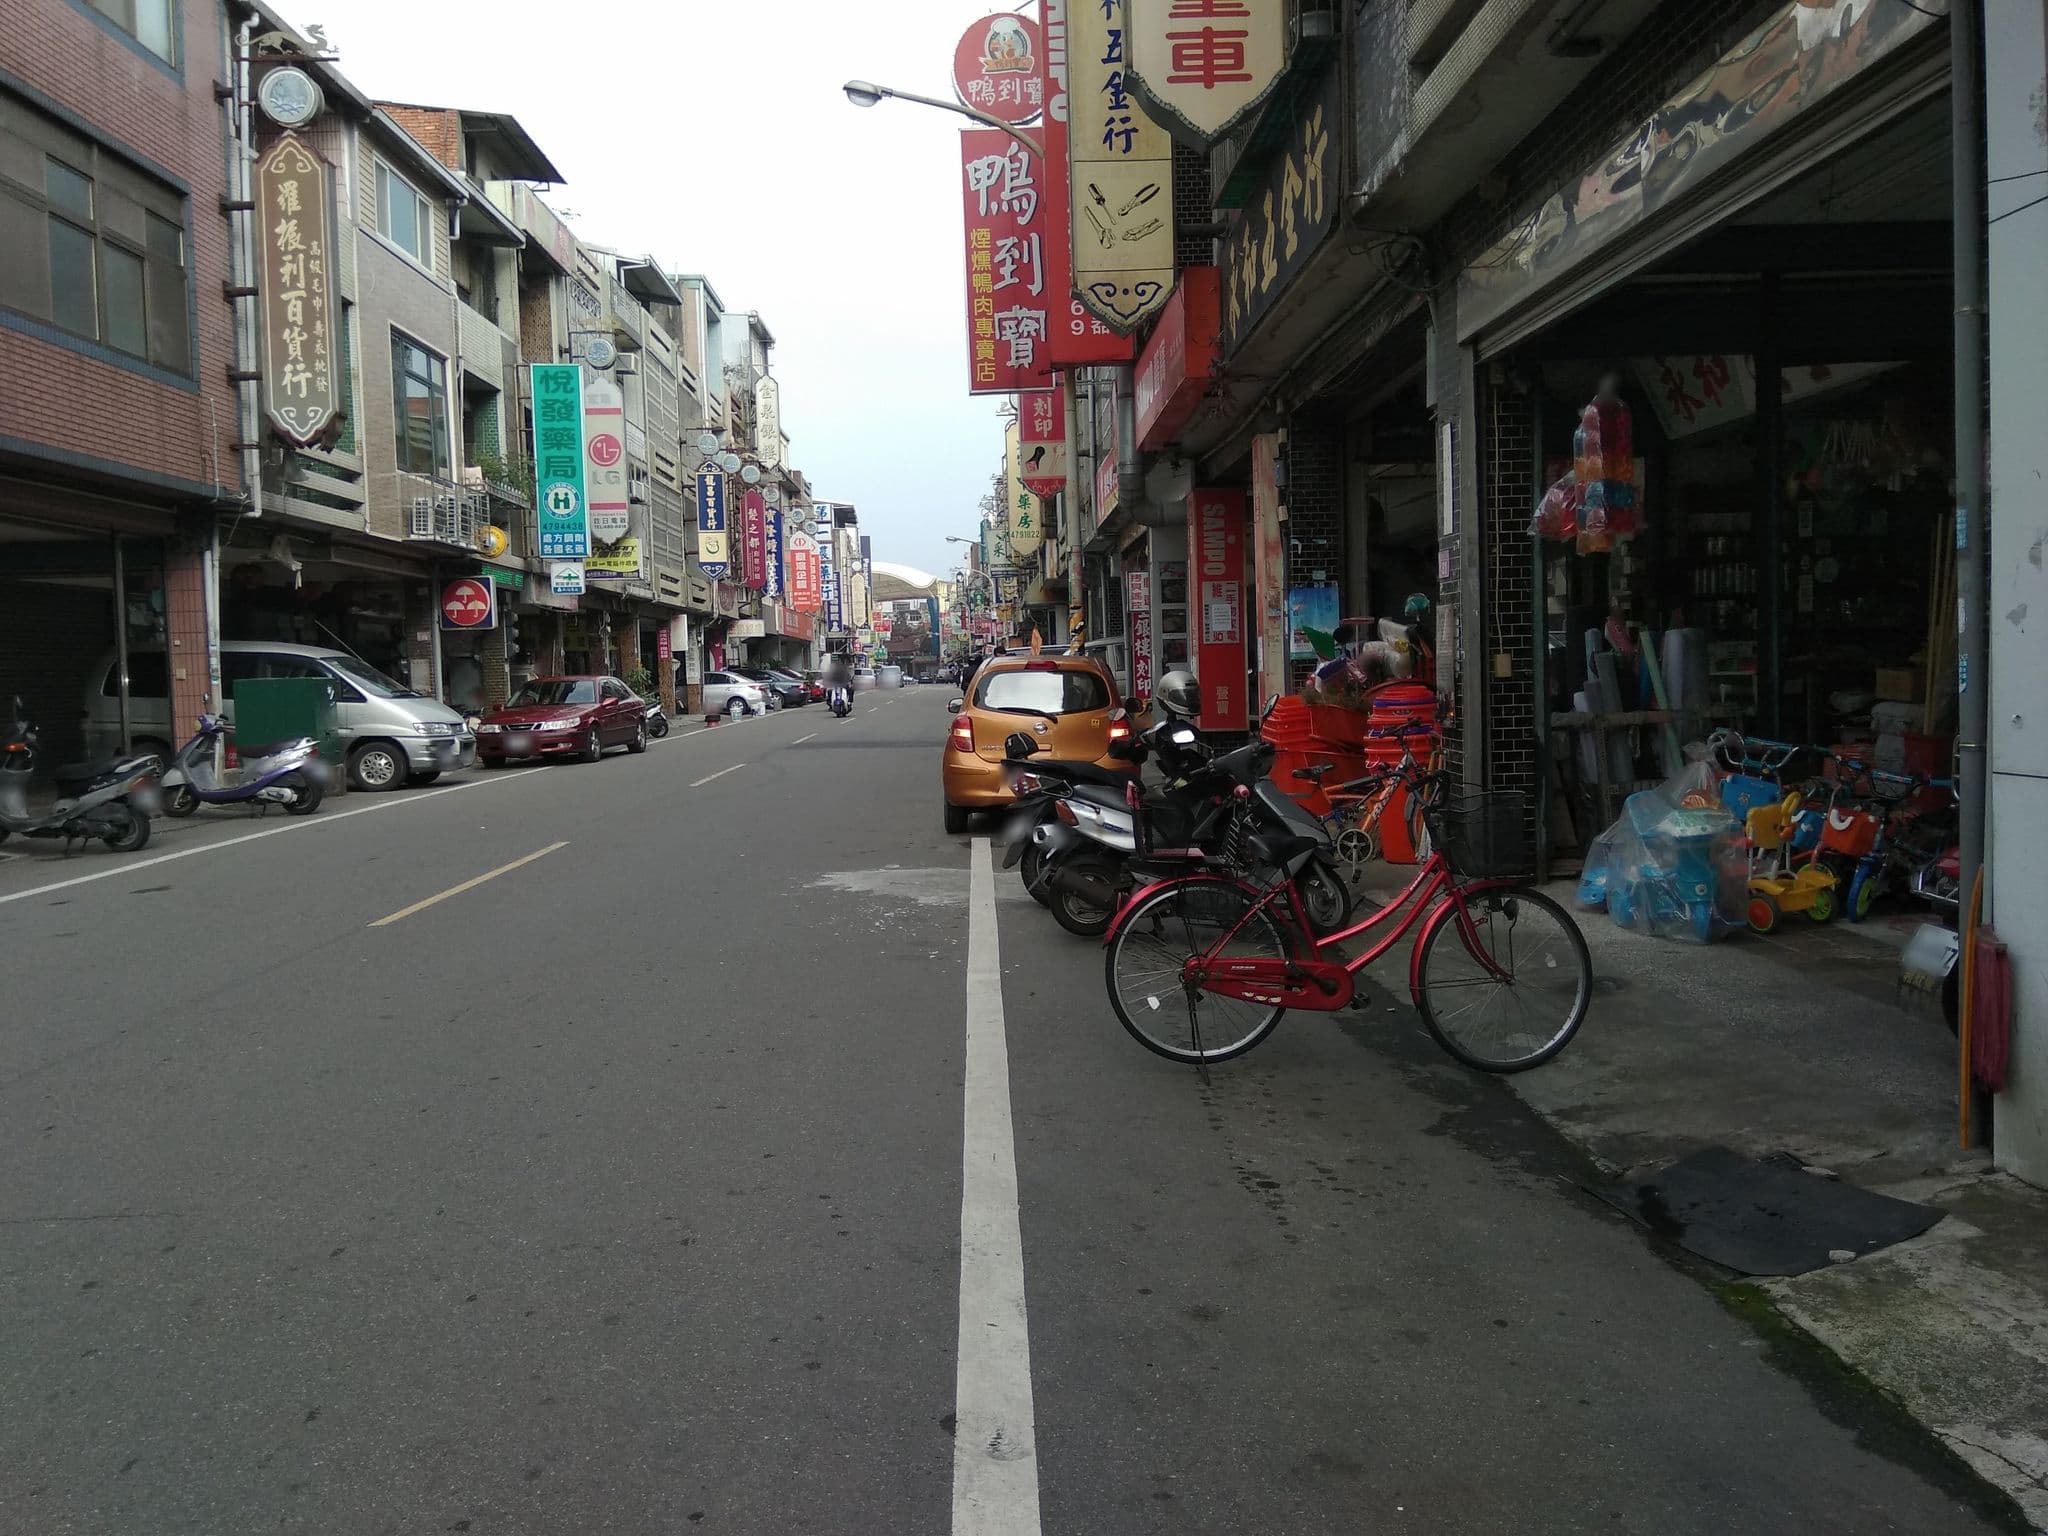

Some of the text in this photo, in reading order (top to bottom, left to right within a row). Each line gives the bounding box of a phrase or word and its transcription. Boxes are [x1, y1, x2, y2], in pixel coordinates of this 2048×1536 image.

[967, 76, 1043, 105] 鴨到寶
[275, 180, 312, 398] 羅振利百貨行
[966, 141, 1047, 369] 鴨到寶
[971, 228, 996, 382] 煙燻鴨肉專賣店
[540, 370, 577, 479] 悅發藥局
[1033, 397, 1053, 438] 刻印
[592, 470, 621, 485] LG
[1202, 503, 1226, 576] SAMPO
